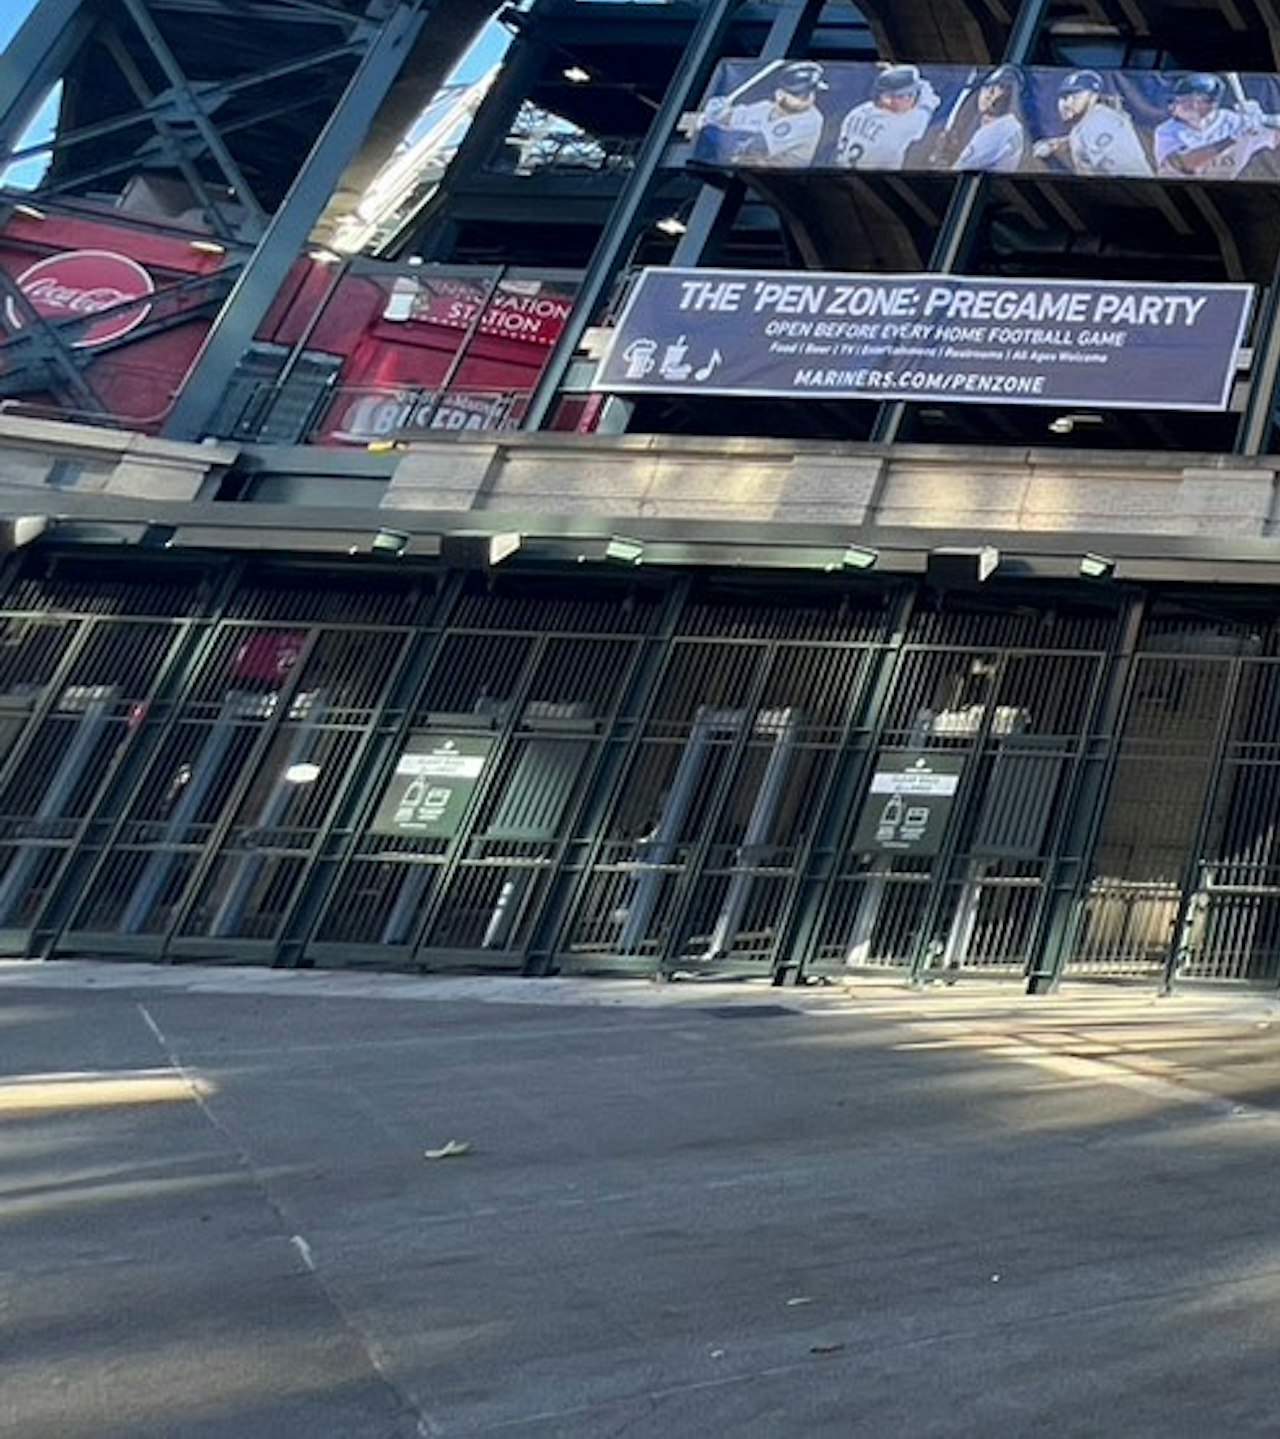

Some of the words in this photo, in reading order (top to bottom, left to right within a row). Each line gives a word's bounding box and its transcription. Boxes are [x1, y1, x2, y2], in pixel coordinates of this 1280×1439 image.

[679, 281, 746, 311] THE
[753, 280, 826, 314] 'PEN
[825, 286, 921, 317] ZONE:
[923, 287, 1087, 323] PREGAME
[1093, 294, 1206, 326] PARTY
[765, 319, 814, 337] OPEN
[814, 321, 882, 340] BEFORE
[881, 323, 936, 341] EVERY
[934, 325, 987, 343] HOME
[988, 326, 1073, 345] FOOTBALL
[1077, 329, 1127, 347] GAME
[793, 367, 1047, 394] MARINERS.COM/PENZONE
